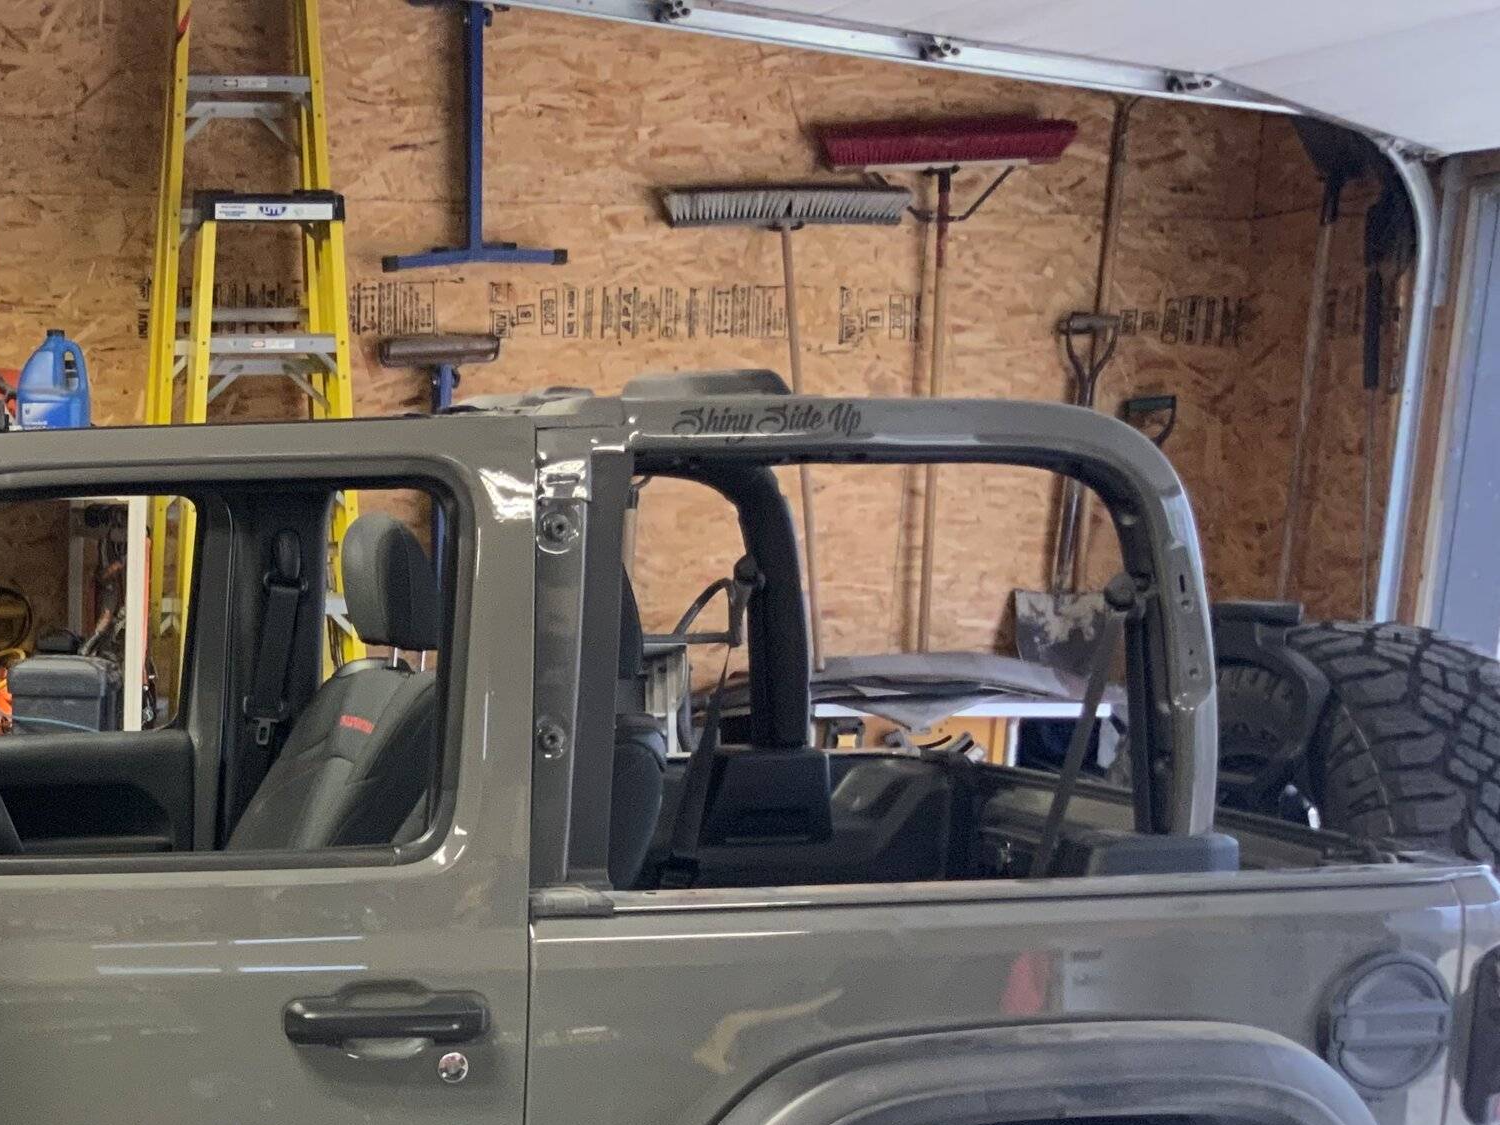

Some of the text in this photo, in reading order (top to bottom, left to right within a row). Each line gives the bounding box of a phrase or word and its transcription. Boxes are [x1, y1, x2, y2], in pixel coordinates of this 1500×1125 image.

[672, 402, 862, 444] Shiny Side Up
